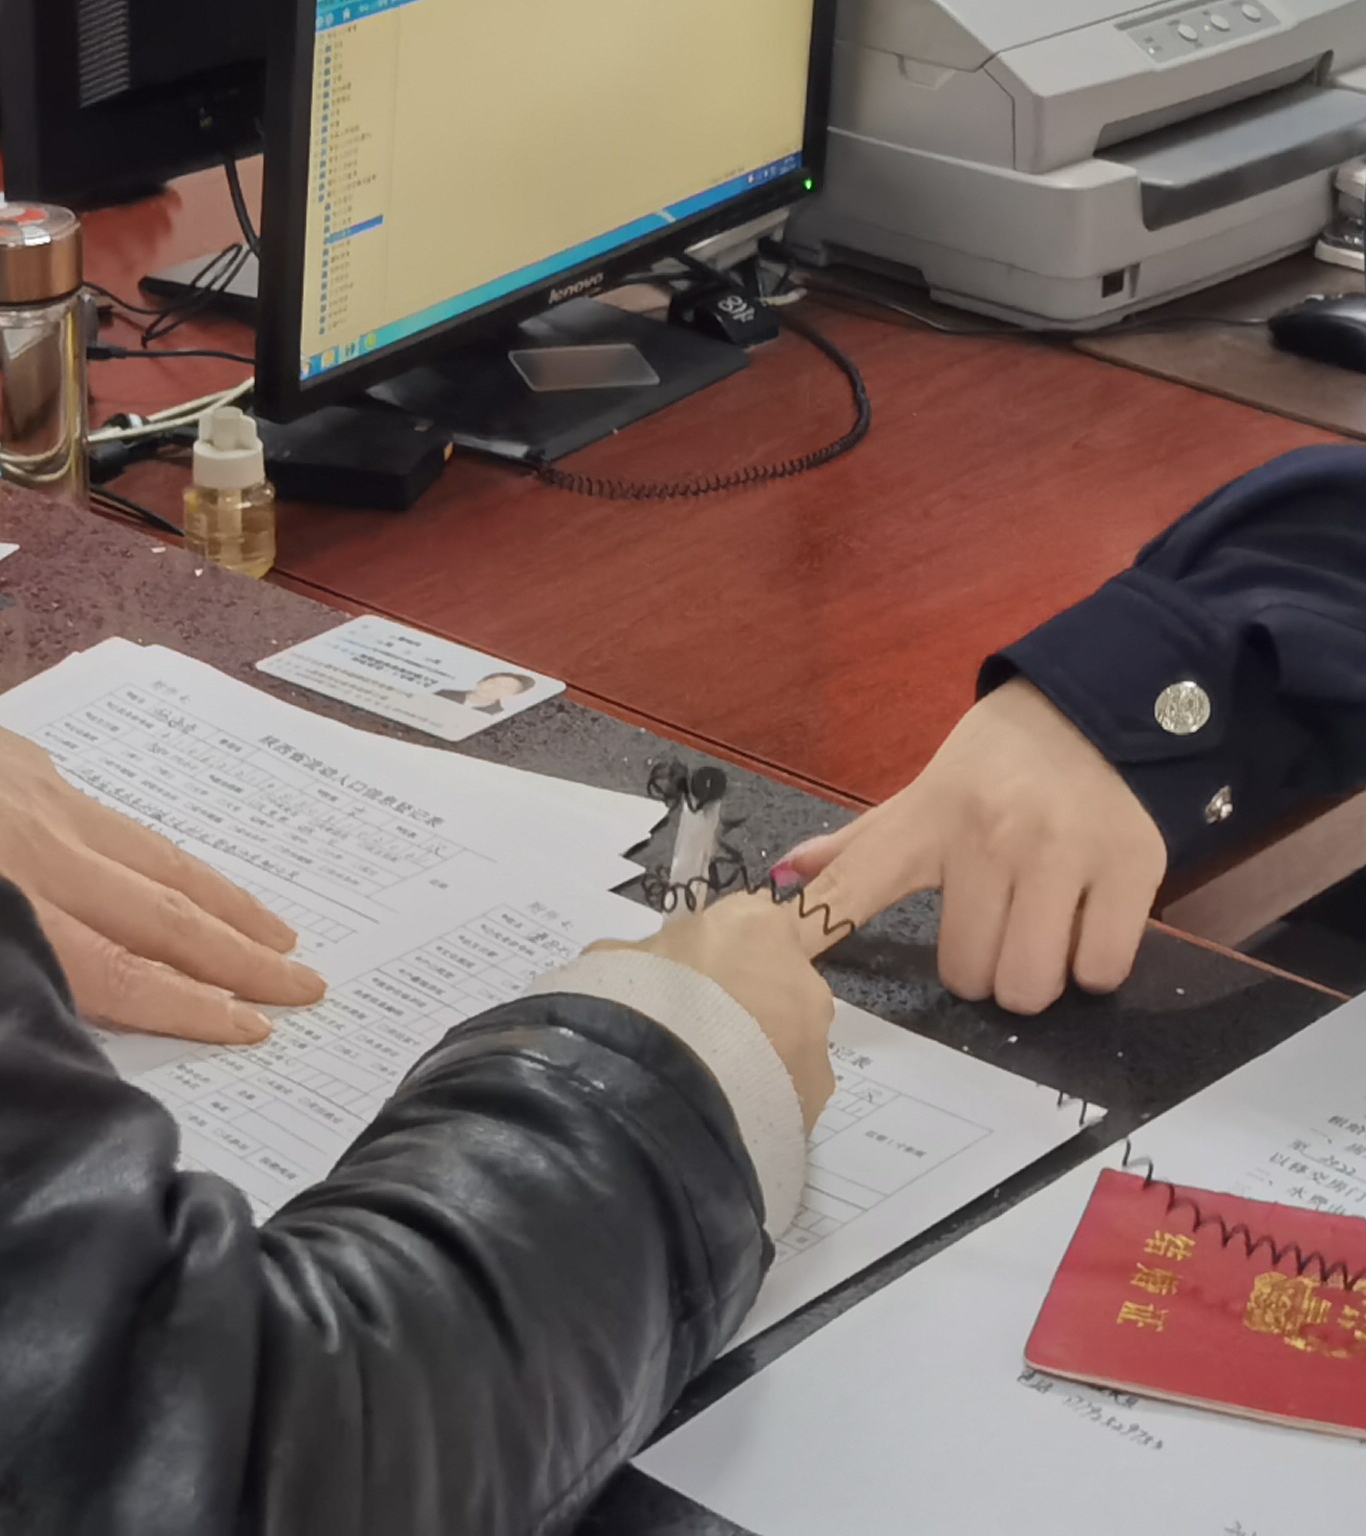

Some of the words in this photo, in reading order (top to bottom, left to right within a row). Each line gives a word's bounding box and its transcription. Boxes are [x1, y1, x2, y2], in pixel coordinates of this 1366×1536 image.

[548, 272, 604, 305] lenovo
[1115, 1228, 1197, 1333] 结婚证
